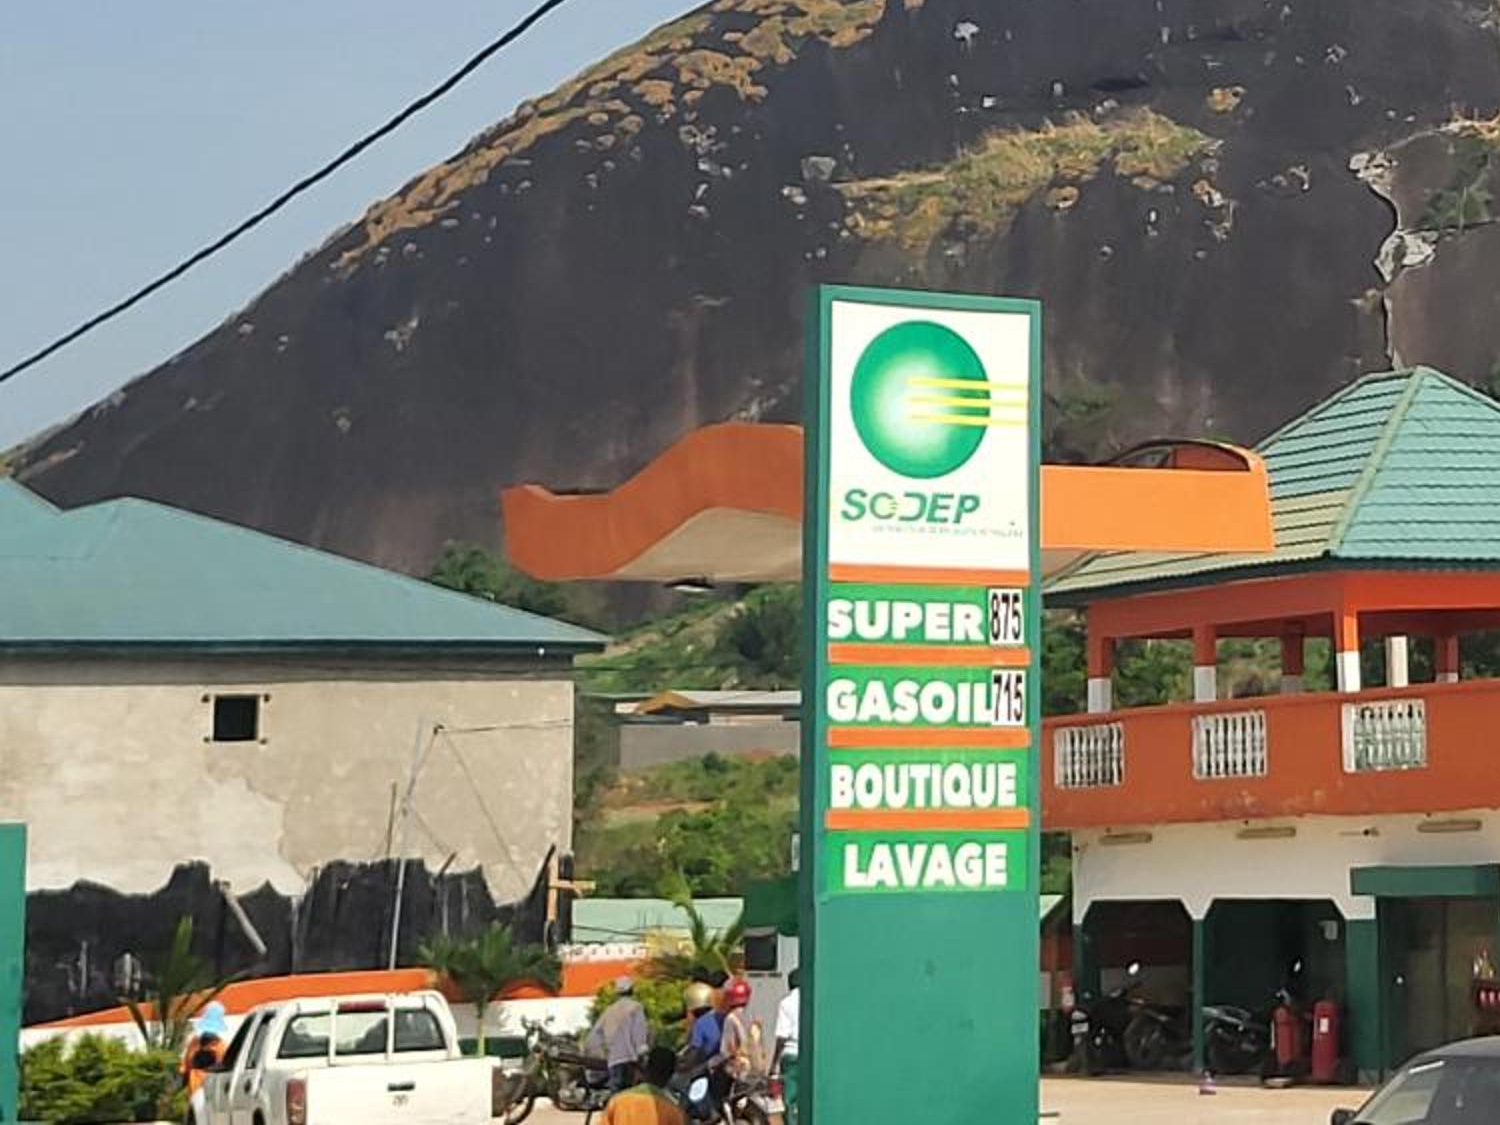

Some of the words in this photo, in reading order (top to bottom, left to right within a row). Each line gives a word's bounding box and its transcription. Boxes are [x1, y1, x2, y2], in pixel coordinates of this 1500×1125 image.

[841, 488, 981, 525] SODEP
[827, 598, 985, 641] SUPER
[991, 592, 1022, 641] 875
[827, 679, 993, 724] GASOIL
[993, 673, 1024, 722] 715
[831, 762, 1017, 809] BOUTIQUE
[843, 842, 1008, 888] LAVAGE
